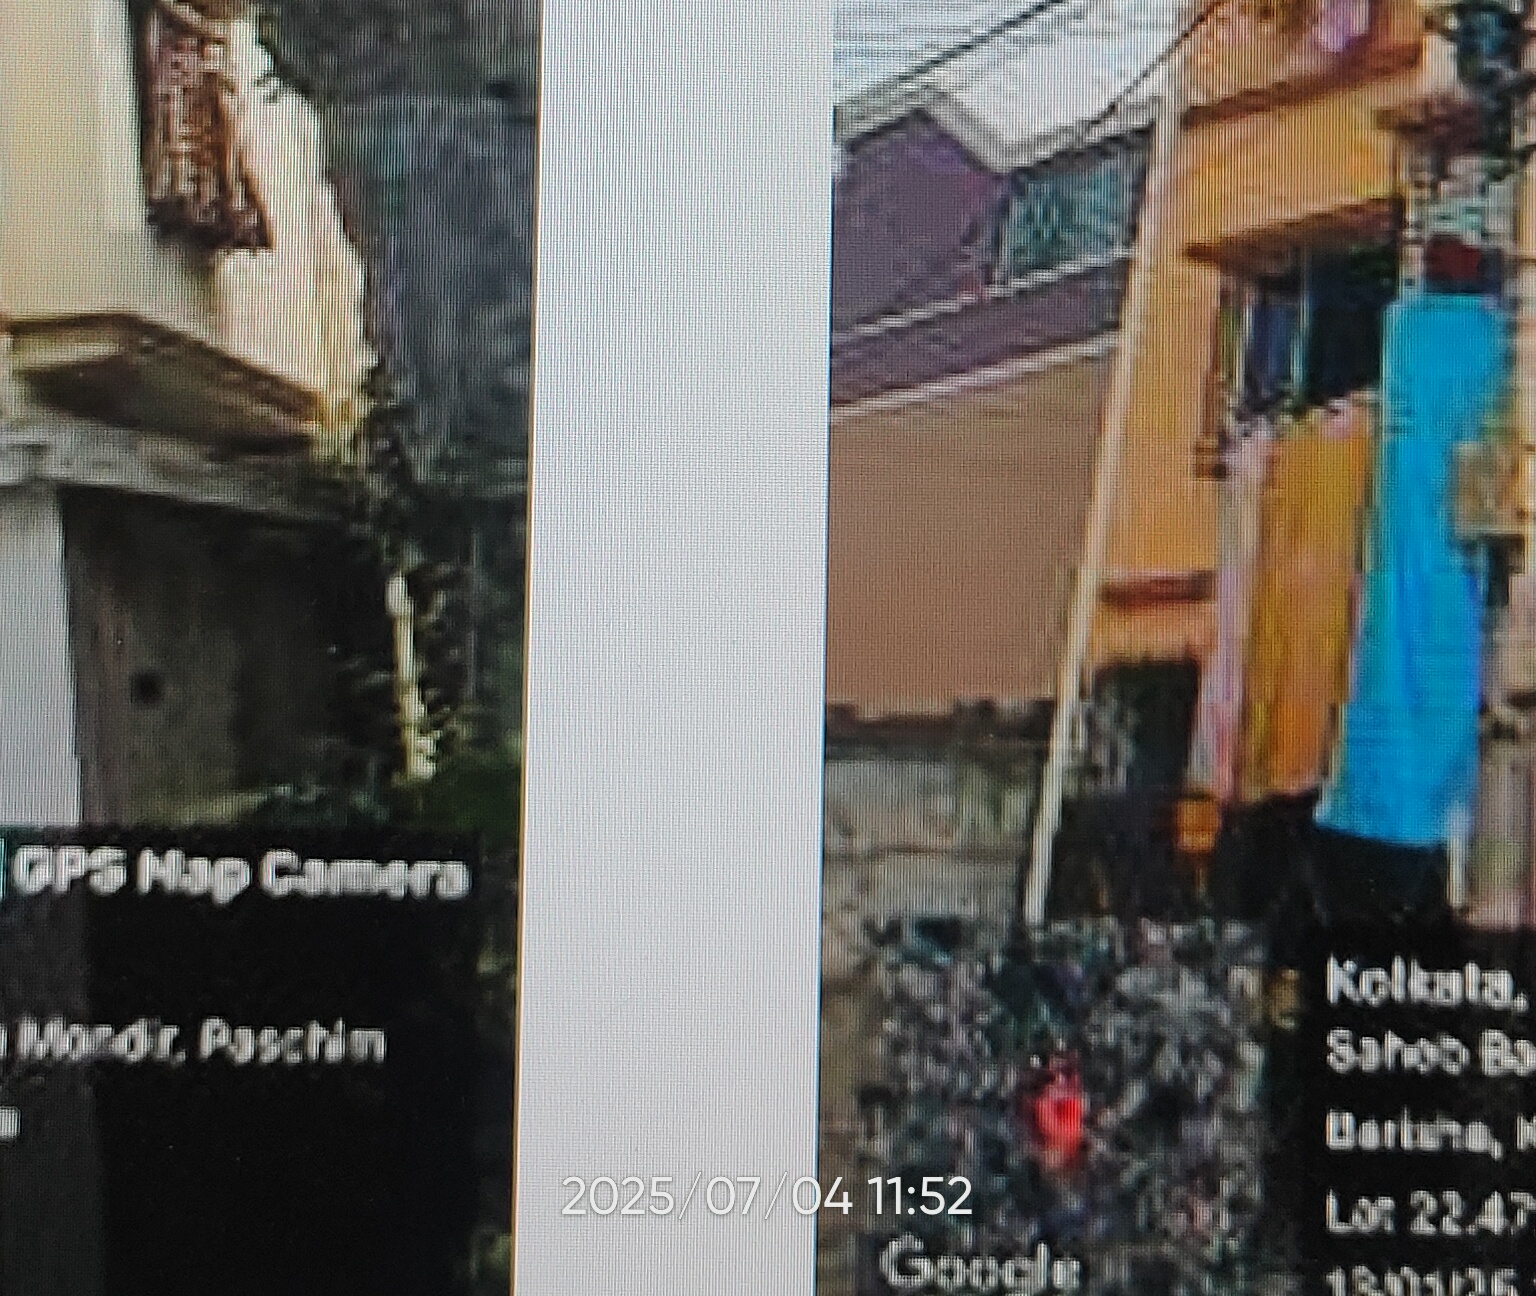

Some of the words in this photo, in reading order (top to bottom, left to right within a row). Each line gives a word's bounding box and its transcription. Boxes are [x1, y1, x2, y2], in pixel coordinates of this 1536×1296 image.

[13, 844, 127, 895] GPS
[137, 847, 251, 904] Map
[262, 848, 471, 900] Camera
[1326, 953, 1528, 1013] Kolkata,
[198, 1015, 387, 1066] Paschim
[1326, 1188, 1395, 1234] Lat
[879, 1232, 1082, 1296] Google
